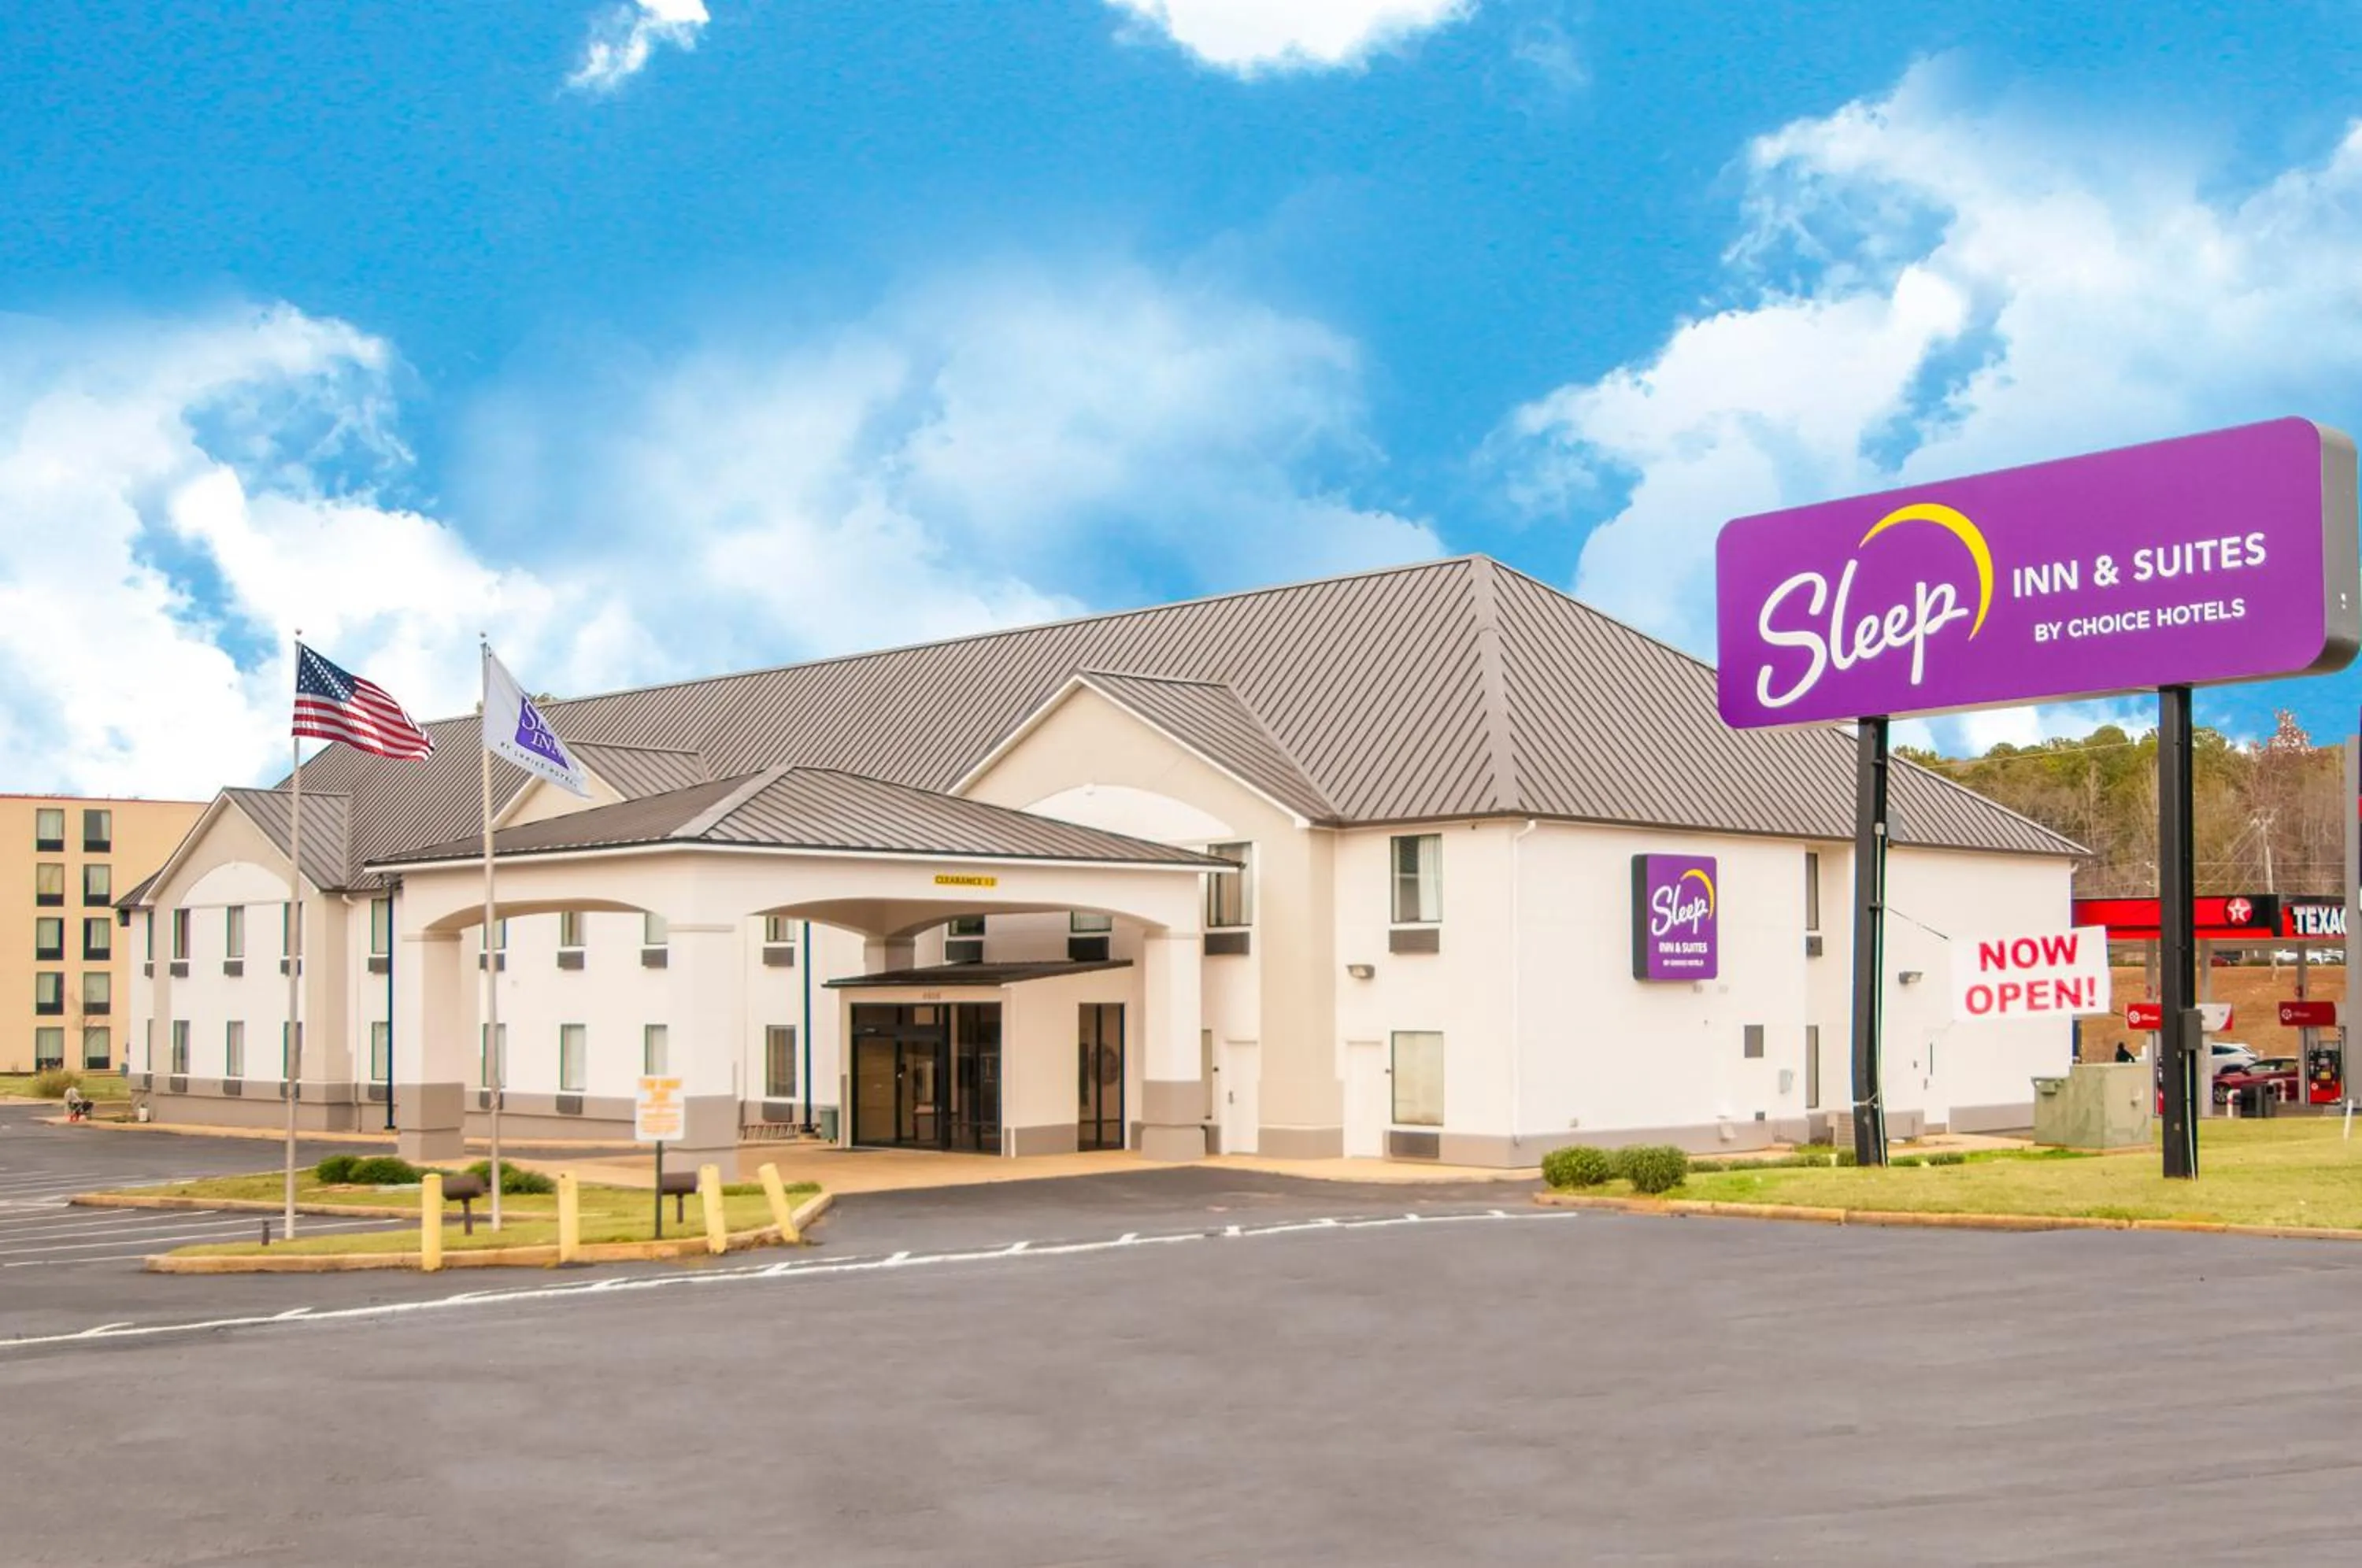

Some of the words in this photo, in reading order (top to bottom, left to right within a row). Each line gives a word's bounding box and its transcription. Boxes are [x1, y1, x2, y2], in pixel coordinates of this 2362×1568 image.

[2012, 560, 2079, 598] INN
[2093, 554, 2120, 586] &
[2133, 532, 2267, 582] SUITES
[1756, 558, 1968, 709] Sleep
[2034, 622, 2062, 642] BY
[2067, 609, 2151, 638] CHOICE
[2156, 597, 2246, 627] HOTELS
[935, 875, 982, 886] CLEARANCE
[1650, 883, 1709, 937] Sleep
[1979, 934, 2079, 973] NOW
[1964, 976, 2096, 1015] OPEN!
